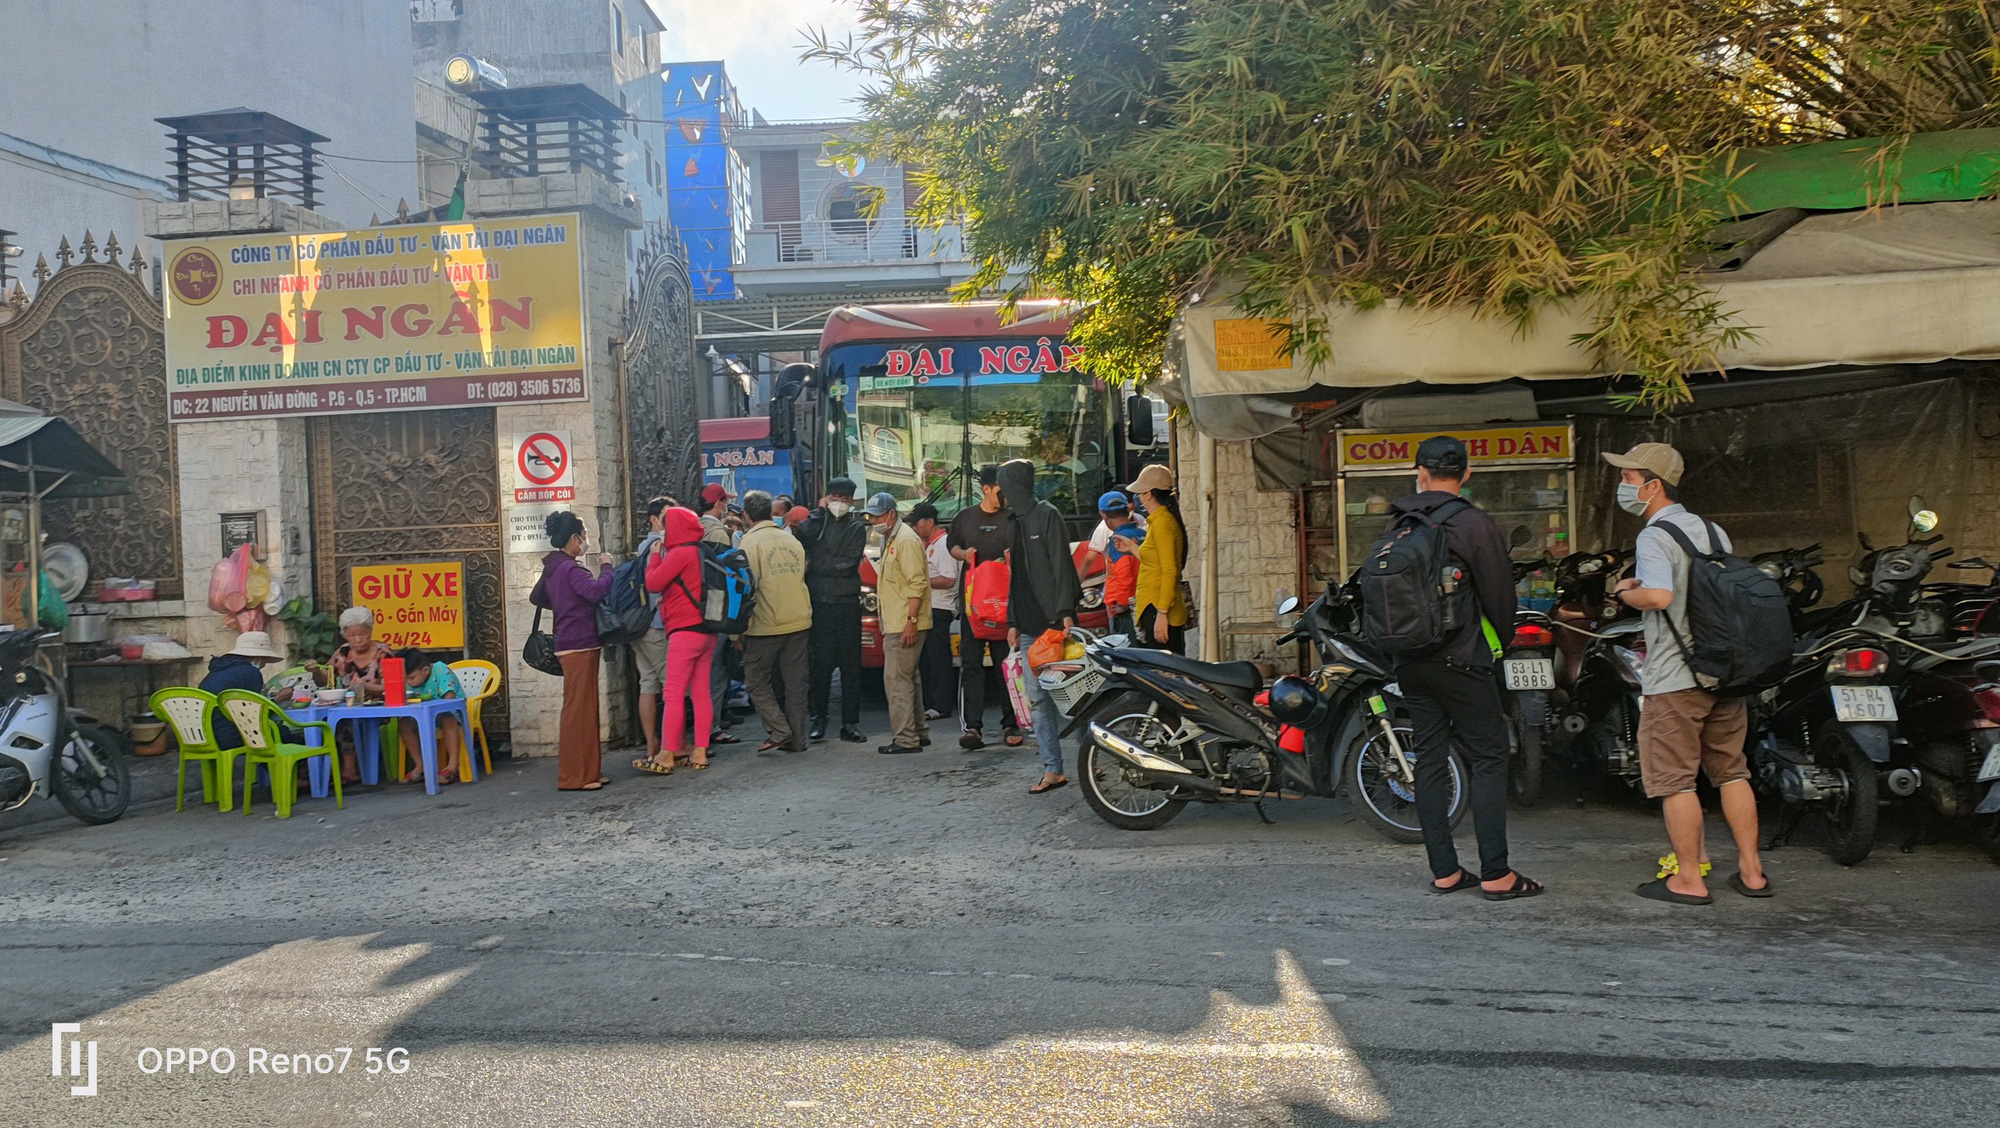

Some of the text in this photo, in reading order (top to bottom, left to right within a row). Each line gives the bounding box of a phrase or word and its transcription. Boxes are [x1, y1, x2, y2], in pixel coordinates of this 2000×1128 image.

[231, 244, 271, 263] CÔNG
[275, 245, 292, 261] TY
[297, 237, 316, 260] CỔ
[320, 235, 361, 258] PHẦN
[365, 233, 394, 255] ĐẦU
[399, 235, 418, 252] TƯ
[431, 231, 461, 254] VẬN
[465, 227, 489, 248] TẢI
[493, 229, 519, 250] ĐẠI
[523, 224, 566, 245] NGÂN
[233, 279, 256, 295] CHI
[313, 268, 332, 290] CỔ
[336, 265, 376, 289] PHẦN
[380, 264, 408, 287] ĐẦU
[412, 265, 431, 284] TƯ
[443, 262, 473, 286] VẬN
[477, 258, 499, 281] TẢI
[206, 290, 534, 352] ĐẠI NGÂN
[176, 368, 198, 388] ĐỊA
[202, 360, 235, 383] ĐIỂM
[239, 363, 270, 381] KINH
[275, 360, 319, 379] DOANH
[323, 360, 341, 377] CN
[346, 358, 369, 376] CTY
[373, 357, 391, 374] CP
[395, 350, 421, 373] ĐẦU
[425, 352, 443, 371] TƯ
[455, 349, 482, 372] VẬN
[510, 349, 533, 370] ĐẠI
[537, 344, 576, 364] NGÂN
[886, 336, 1086, 384] ĐẠI NGÂN
[173, 399, 193, 414] ĐC:
[195, 398, 210, 413] 22
[212, 390, 258, 412] NGUYỄN
[260, 391, 284, 410] VĂN
[328, 390, 346, 407] P.6
[355, 389, 374, 406] Q.5
[385, 386, 427, 404] TP.HCM
[467, 377, 581, 399] ĐT: (028) 3506 5736
[713, 446, 774, 467] NGÂN
[1349, 438, 1410, 461] CƠM
[1497, 431, 1562, 456] DÂN
[518, 490, 537, 501] CẤM
[358, 568, 458, 600] GIỮ XE
[396, 602, 425, 623] Gắn
[429, 604, 457, 625] Máy
[381, 632, 432, 647] 24/24
[1512, 661, 1544, 674] 63-L1
[1513, 675, 1547, 687] 8986
[1841, 688, 1884, 702] 51-R4
